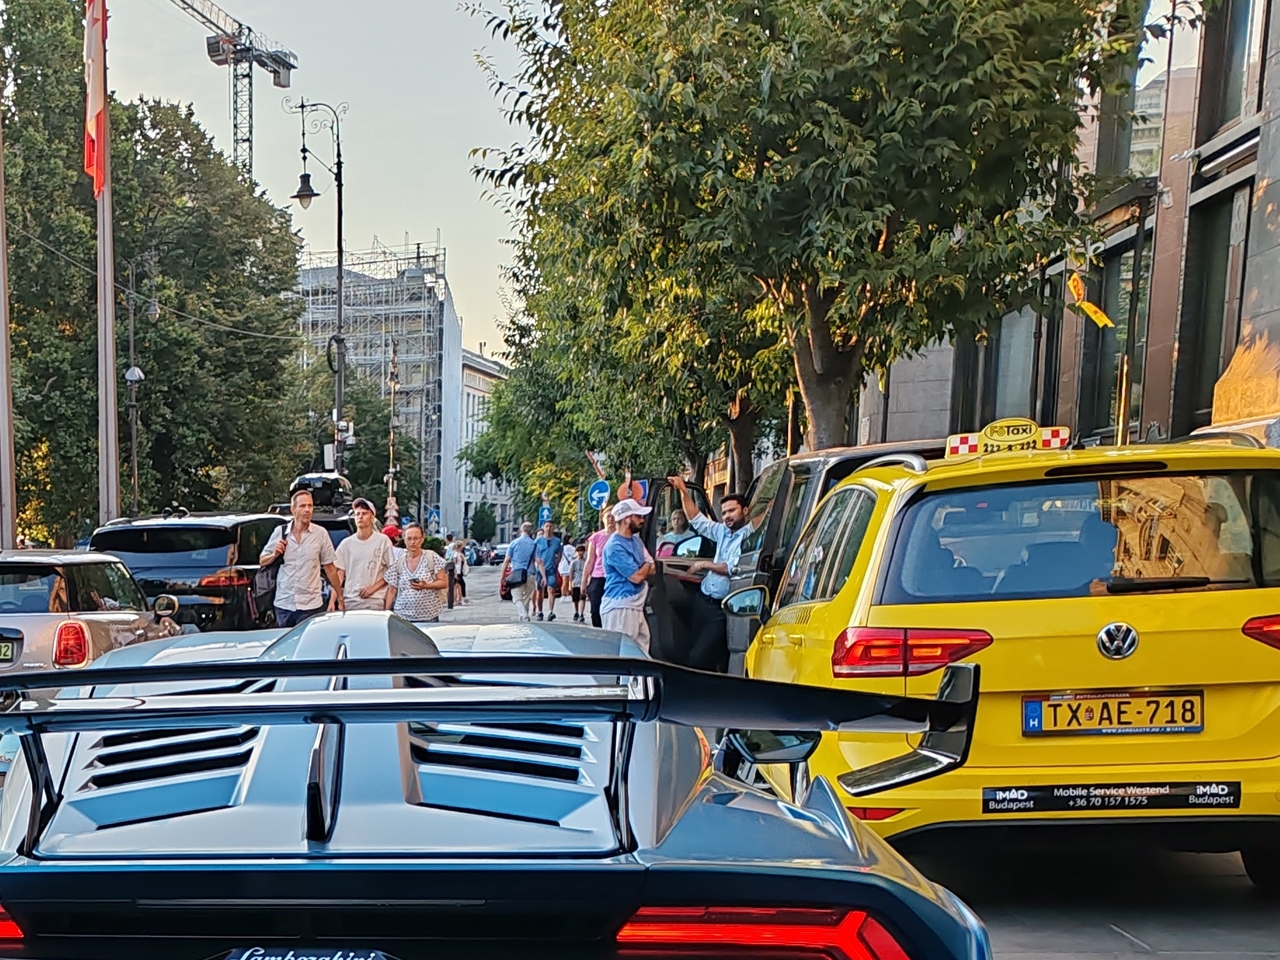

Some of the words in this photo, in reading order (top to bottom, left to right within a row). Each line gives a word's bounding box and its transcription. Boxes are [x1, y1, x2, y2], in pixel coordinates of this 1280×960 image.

[1047, 702, 1082, 728] TX
[1097, 699, 1196, 726] AE-718
[1029, 718, 1039, 728] H
[1053, 786, 1088, 797] Mobile
[1089, 786, 1125, 796] Service
[1126, 785, 1170, 795] Westend
[988, 800, 1035, 811] Budapest
[1068, 798, 1087, 808] +36
[1089, 798, 1102, 807] 70
[1104, 797, 1121, 806] 157
[1124, 796, 1149, 806] 1575
[1188, 795, 1235, 806] Budapest
